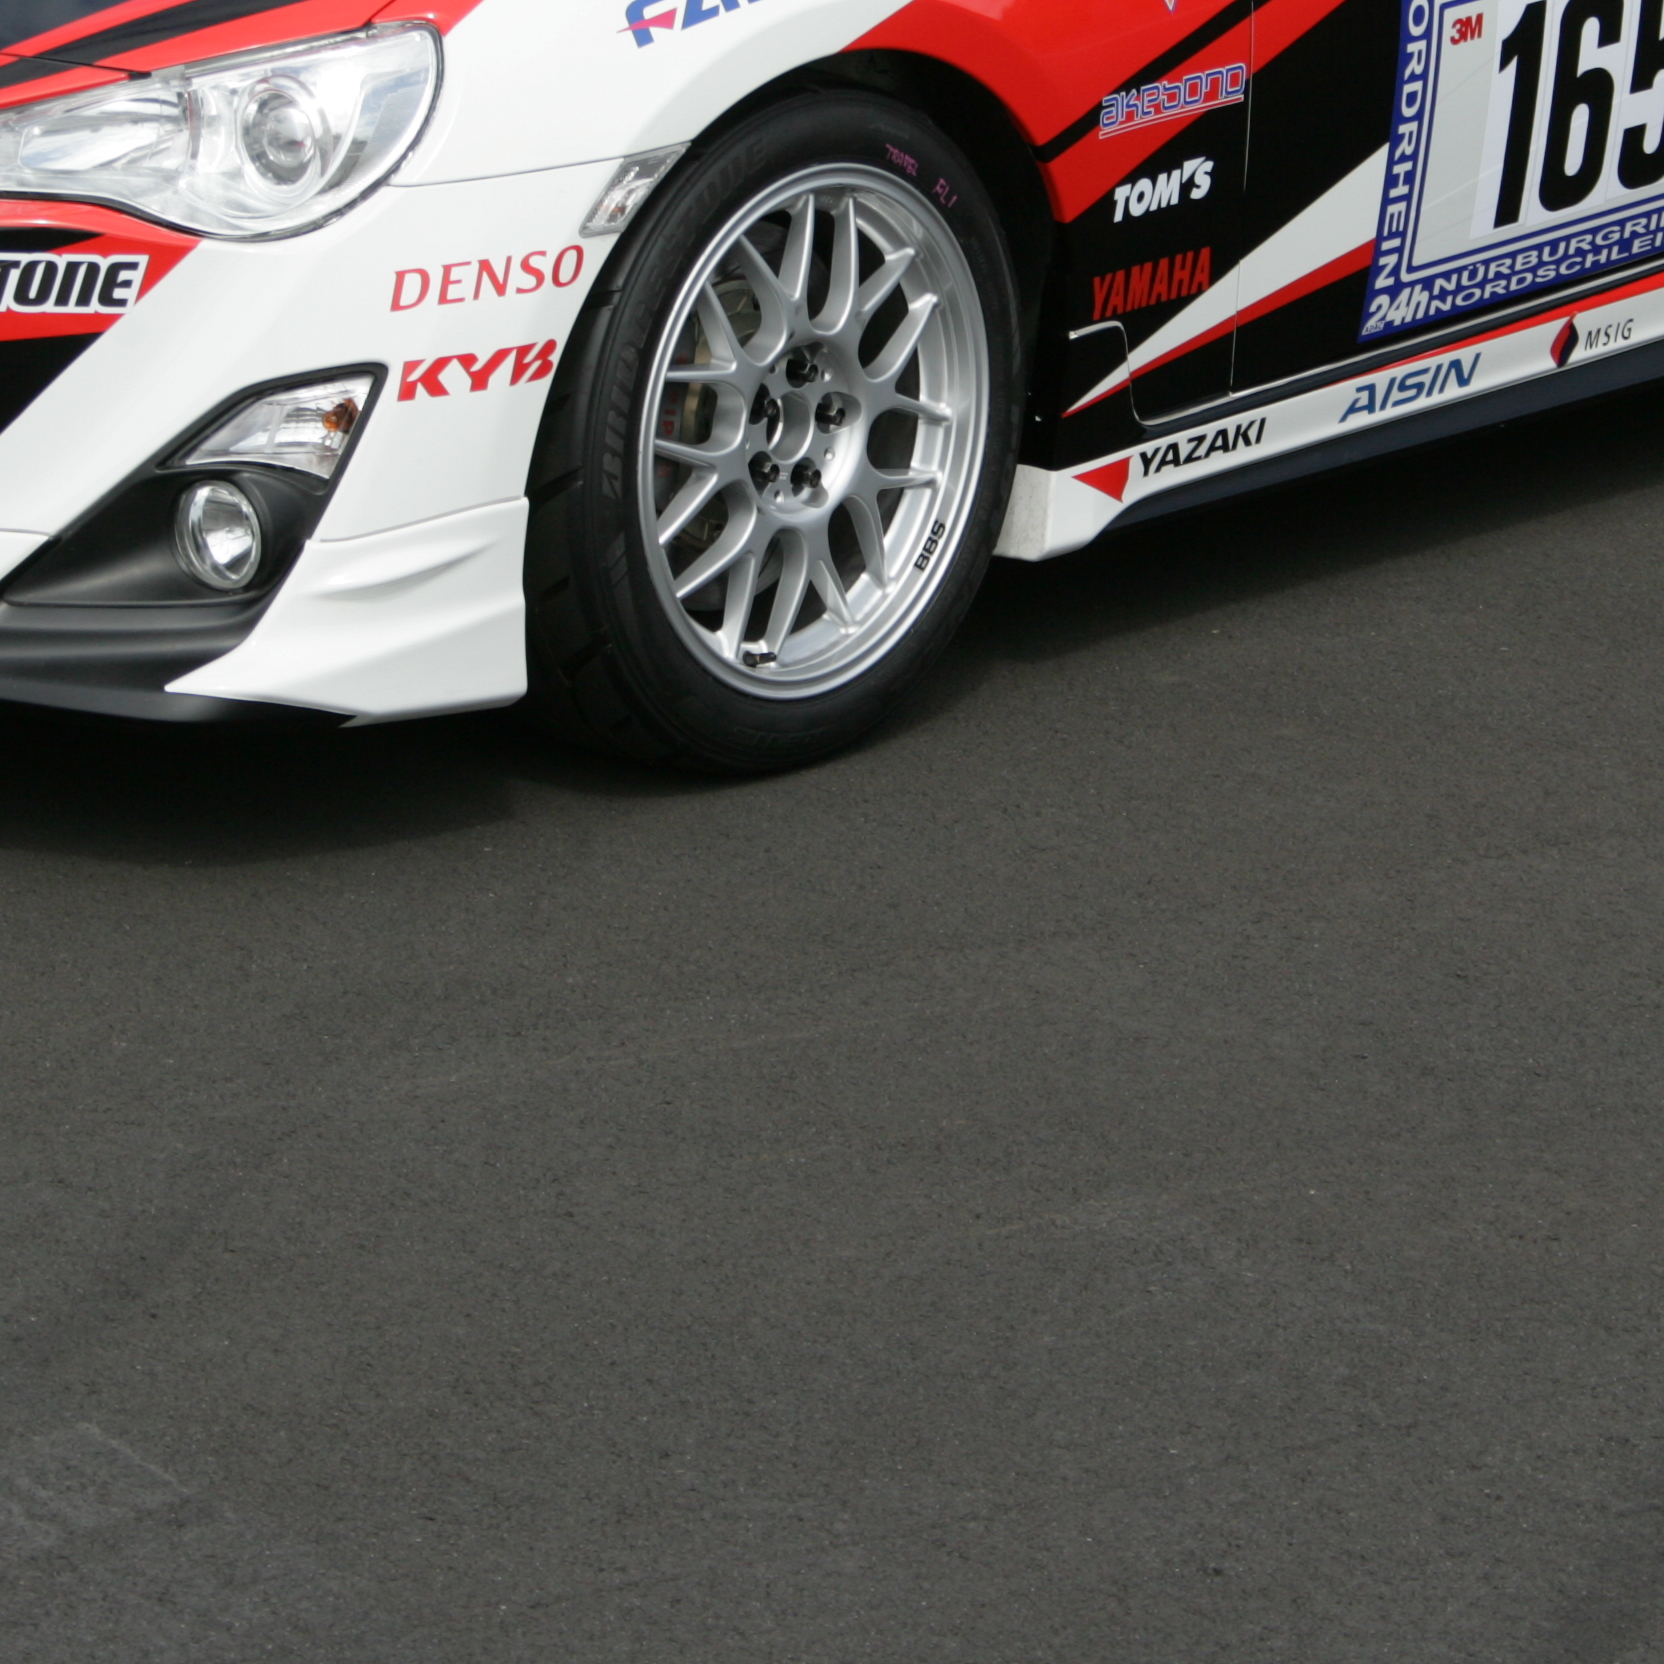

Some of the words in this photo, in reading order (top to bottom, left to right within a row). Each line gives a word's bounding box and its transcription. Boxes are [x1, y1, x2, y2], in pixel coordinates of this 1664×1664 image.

[1450, 12, 1484, 45] 3M
[1113, 156, 1215, 224] TOM'S
[389, 242, 585, 313] DENSO
[1092, 245, 1211, 321] YAMAHA
[1368, 283, 1430, 331] 24h
[1584, 318, 1634, 352] MSIG
[396, 337, 559, 403] KYB
[1338, 352, 1483, 424] AISIN
[1139, 417, 1267, 478] YAZAKI
[913, 517, 947, 573] BBS
